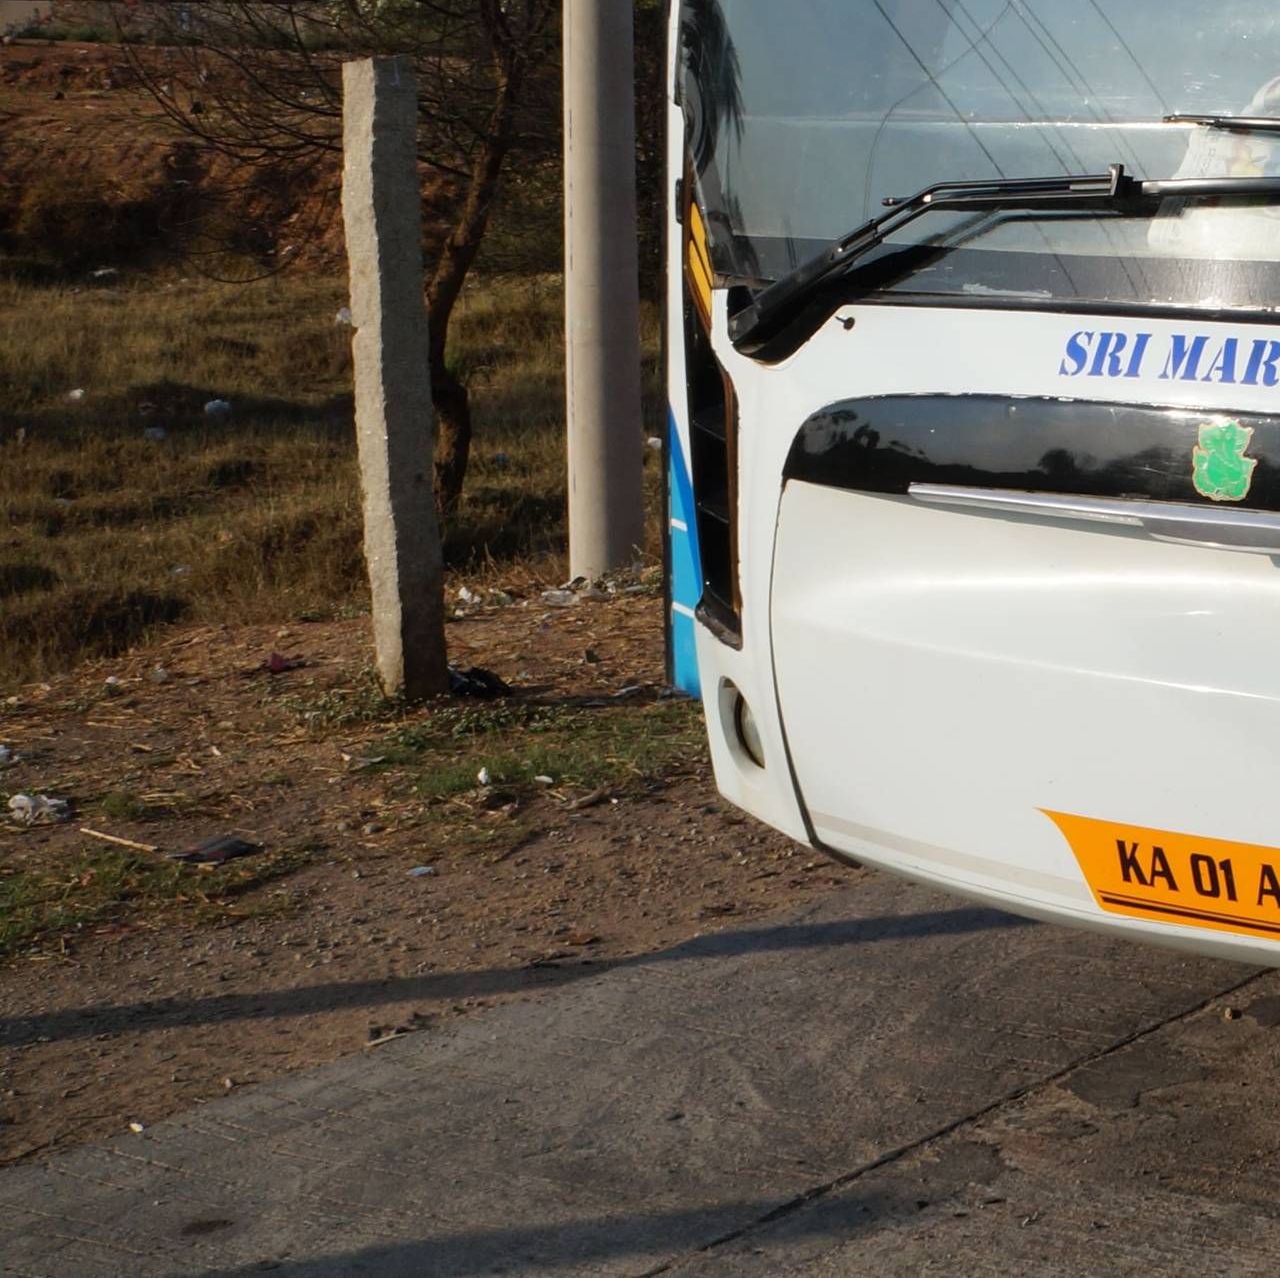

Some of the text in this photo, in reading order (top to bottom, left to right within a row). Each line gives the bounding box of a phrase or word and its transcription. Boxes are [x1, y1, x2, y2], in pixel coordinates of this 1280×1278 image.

[1058, 330, 1153, 378] SRI
[1115, 839, 1180, 892] KA
[1189, 853, 1238, 902] 01
